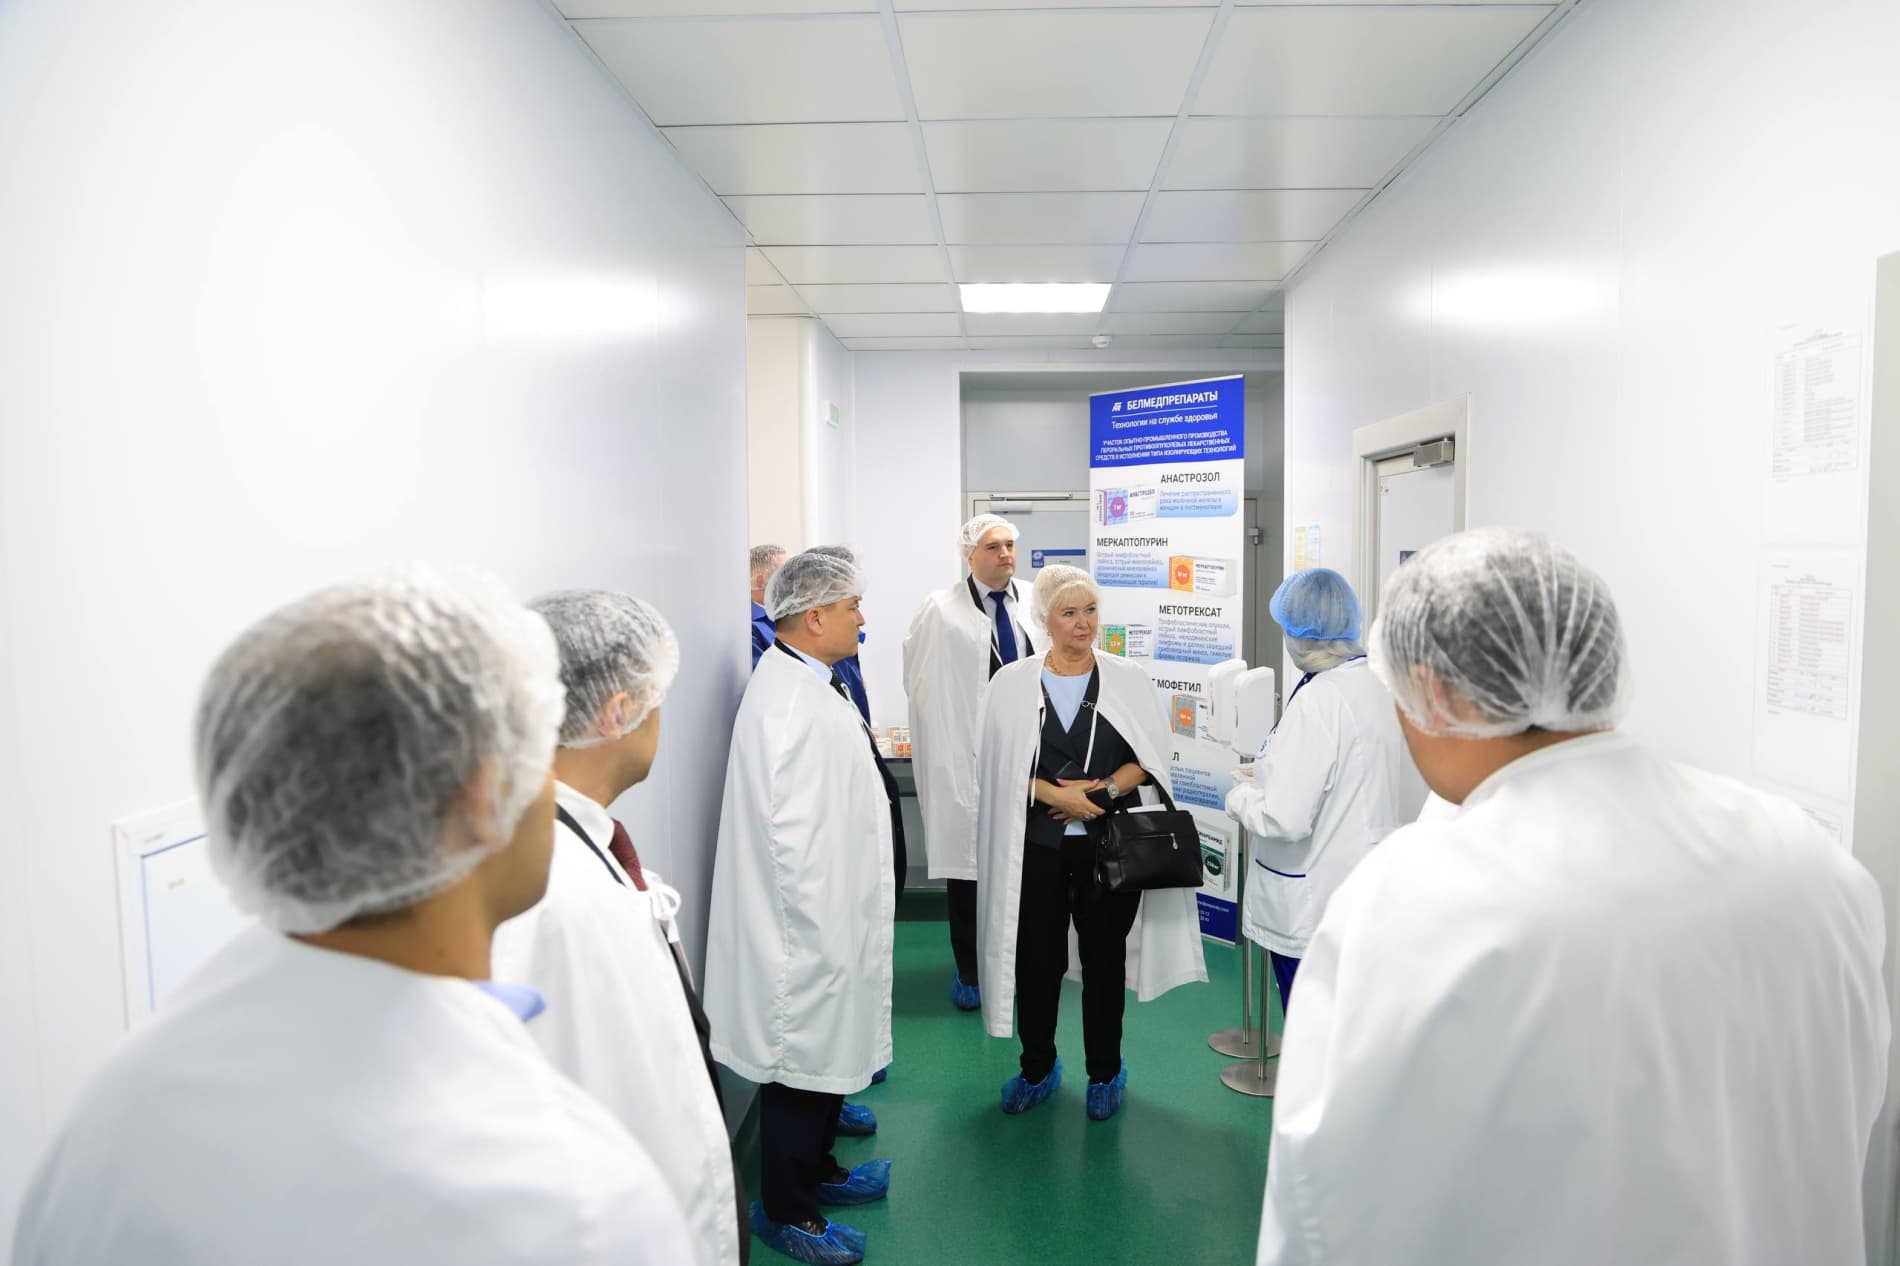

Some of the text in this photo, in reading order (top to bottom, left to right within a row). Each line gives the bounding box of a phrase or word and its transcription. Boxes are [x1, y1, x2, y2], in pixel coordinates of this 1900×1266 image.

[1127, 390, 1218, 410] БЕЛМЕДПРЕПАРАТЫ
[1112, 419, 1148, 429] Технологии
[1158, 414, 1183, 425] службе
[1184, 413, 1218, 423] здоровья
[1160, 472, 1220, 483] АНАСТРОЗОЛ
[1129, 489, 1155, 498] АНАСТРОЗОЛ
[1096, 537, 1168, 547] МЕРКАПТОПУРИН
[1159, 605, 1222, 617] МЕТОТРЕКСАТ
[1157, 679, 1201, 692] МОФЕТИЛ
[1172, 752, 1180, 761] Л
